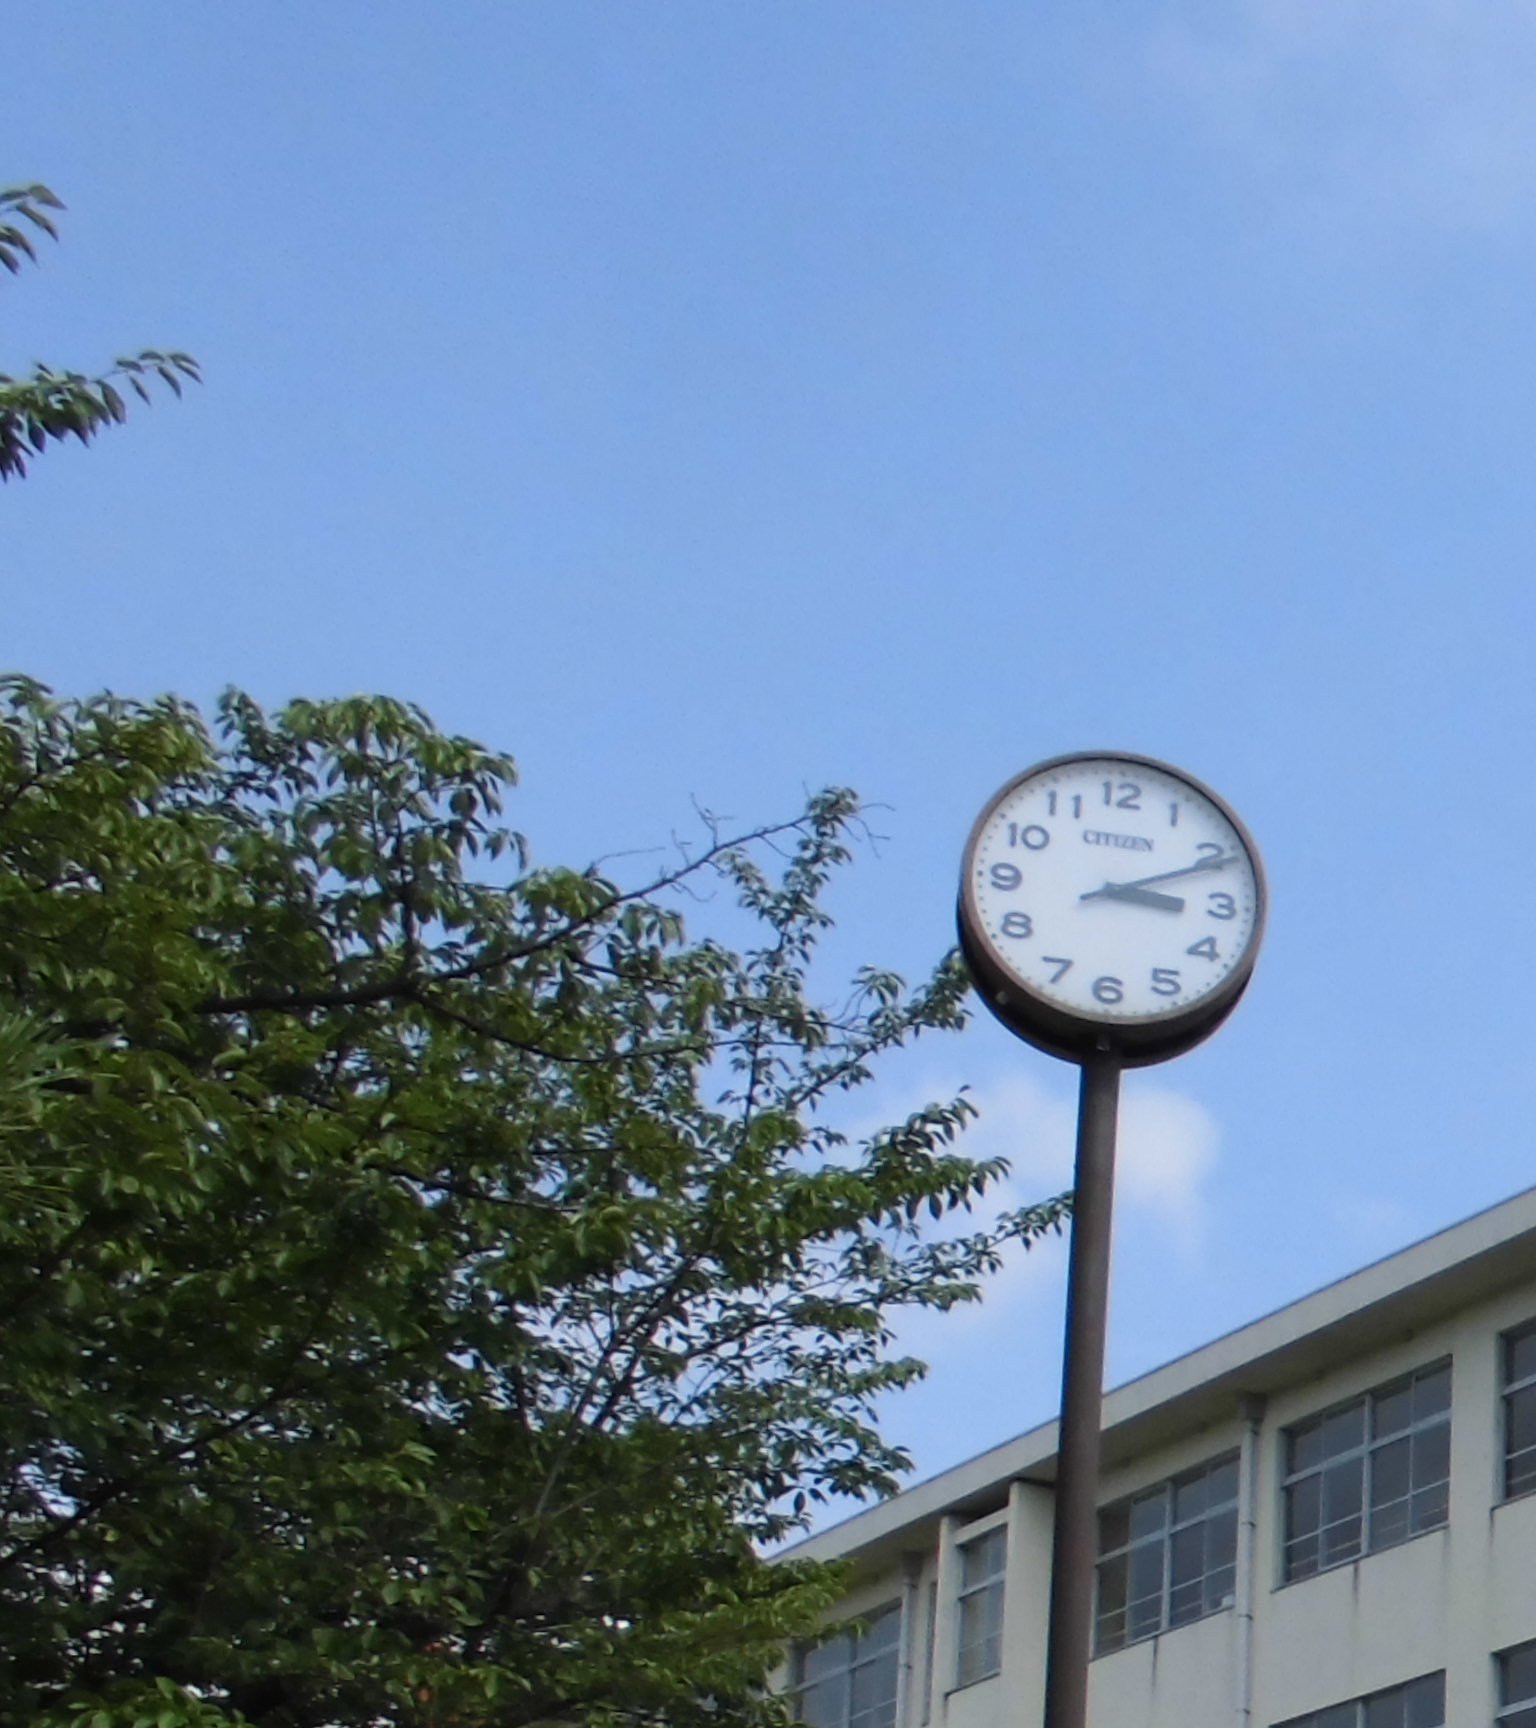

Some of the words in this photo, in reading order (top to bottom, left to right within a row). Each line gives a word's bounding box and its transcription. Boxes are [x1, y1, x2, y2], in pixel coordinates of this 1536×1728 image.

[1048, 790, 1082, 819] 11
[1102, 781, 1142, 811] 12
[1169, 803, 1179, 828] 1
[1008, 822, 1050, 850] 10
[1082, 829, 1154, 852] CITIZEN
[1194, 842, 1225, 872] 2
[990, 862, 1023, 891] 9
[1206, 892, 1237, 920] 3
[1000, 912, 1033, 939] 8
[1186, 936, 1220, 962] 4
[1041, 956, 1074, 984] 7
[1151, 967, 1182, 996] 5
[1091, 976, 1124, 1004] 6
